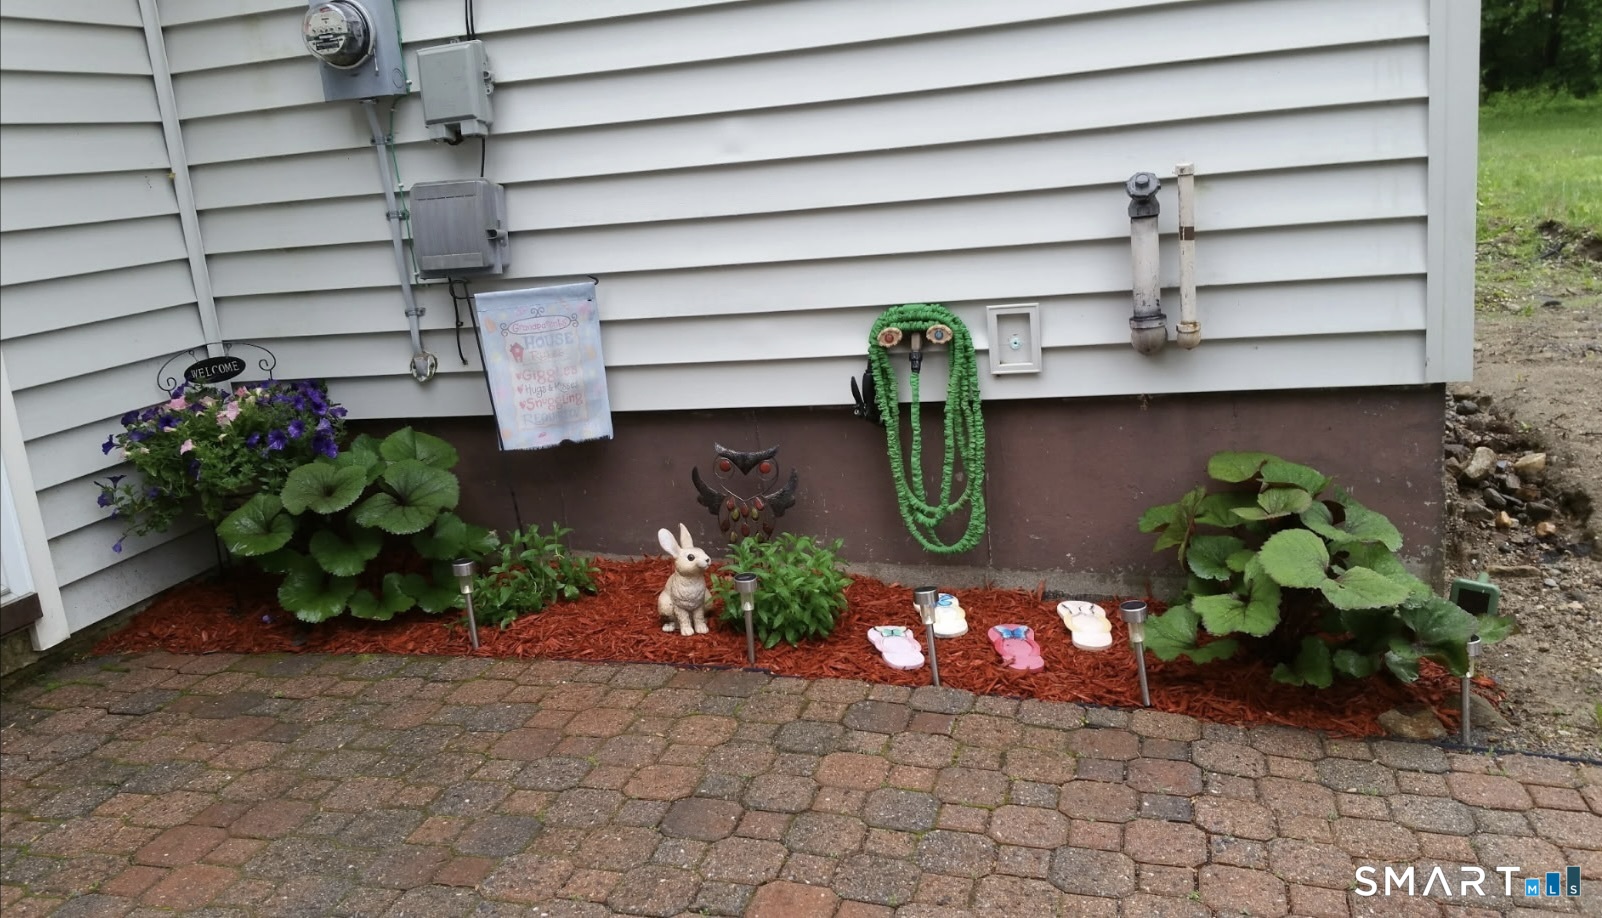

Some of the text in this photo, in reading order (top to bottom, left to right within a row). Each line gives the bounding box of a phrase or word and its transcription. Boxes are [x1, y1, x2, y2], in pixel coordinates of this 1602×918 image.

[524, 333, 574, 349] HOUSE
[191, 361, 240, 379] WELCOME
[525, 384, 547, 398] Hugs
